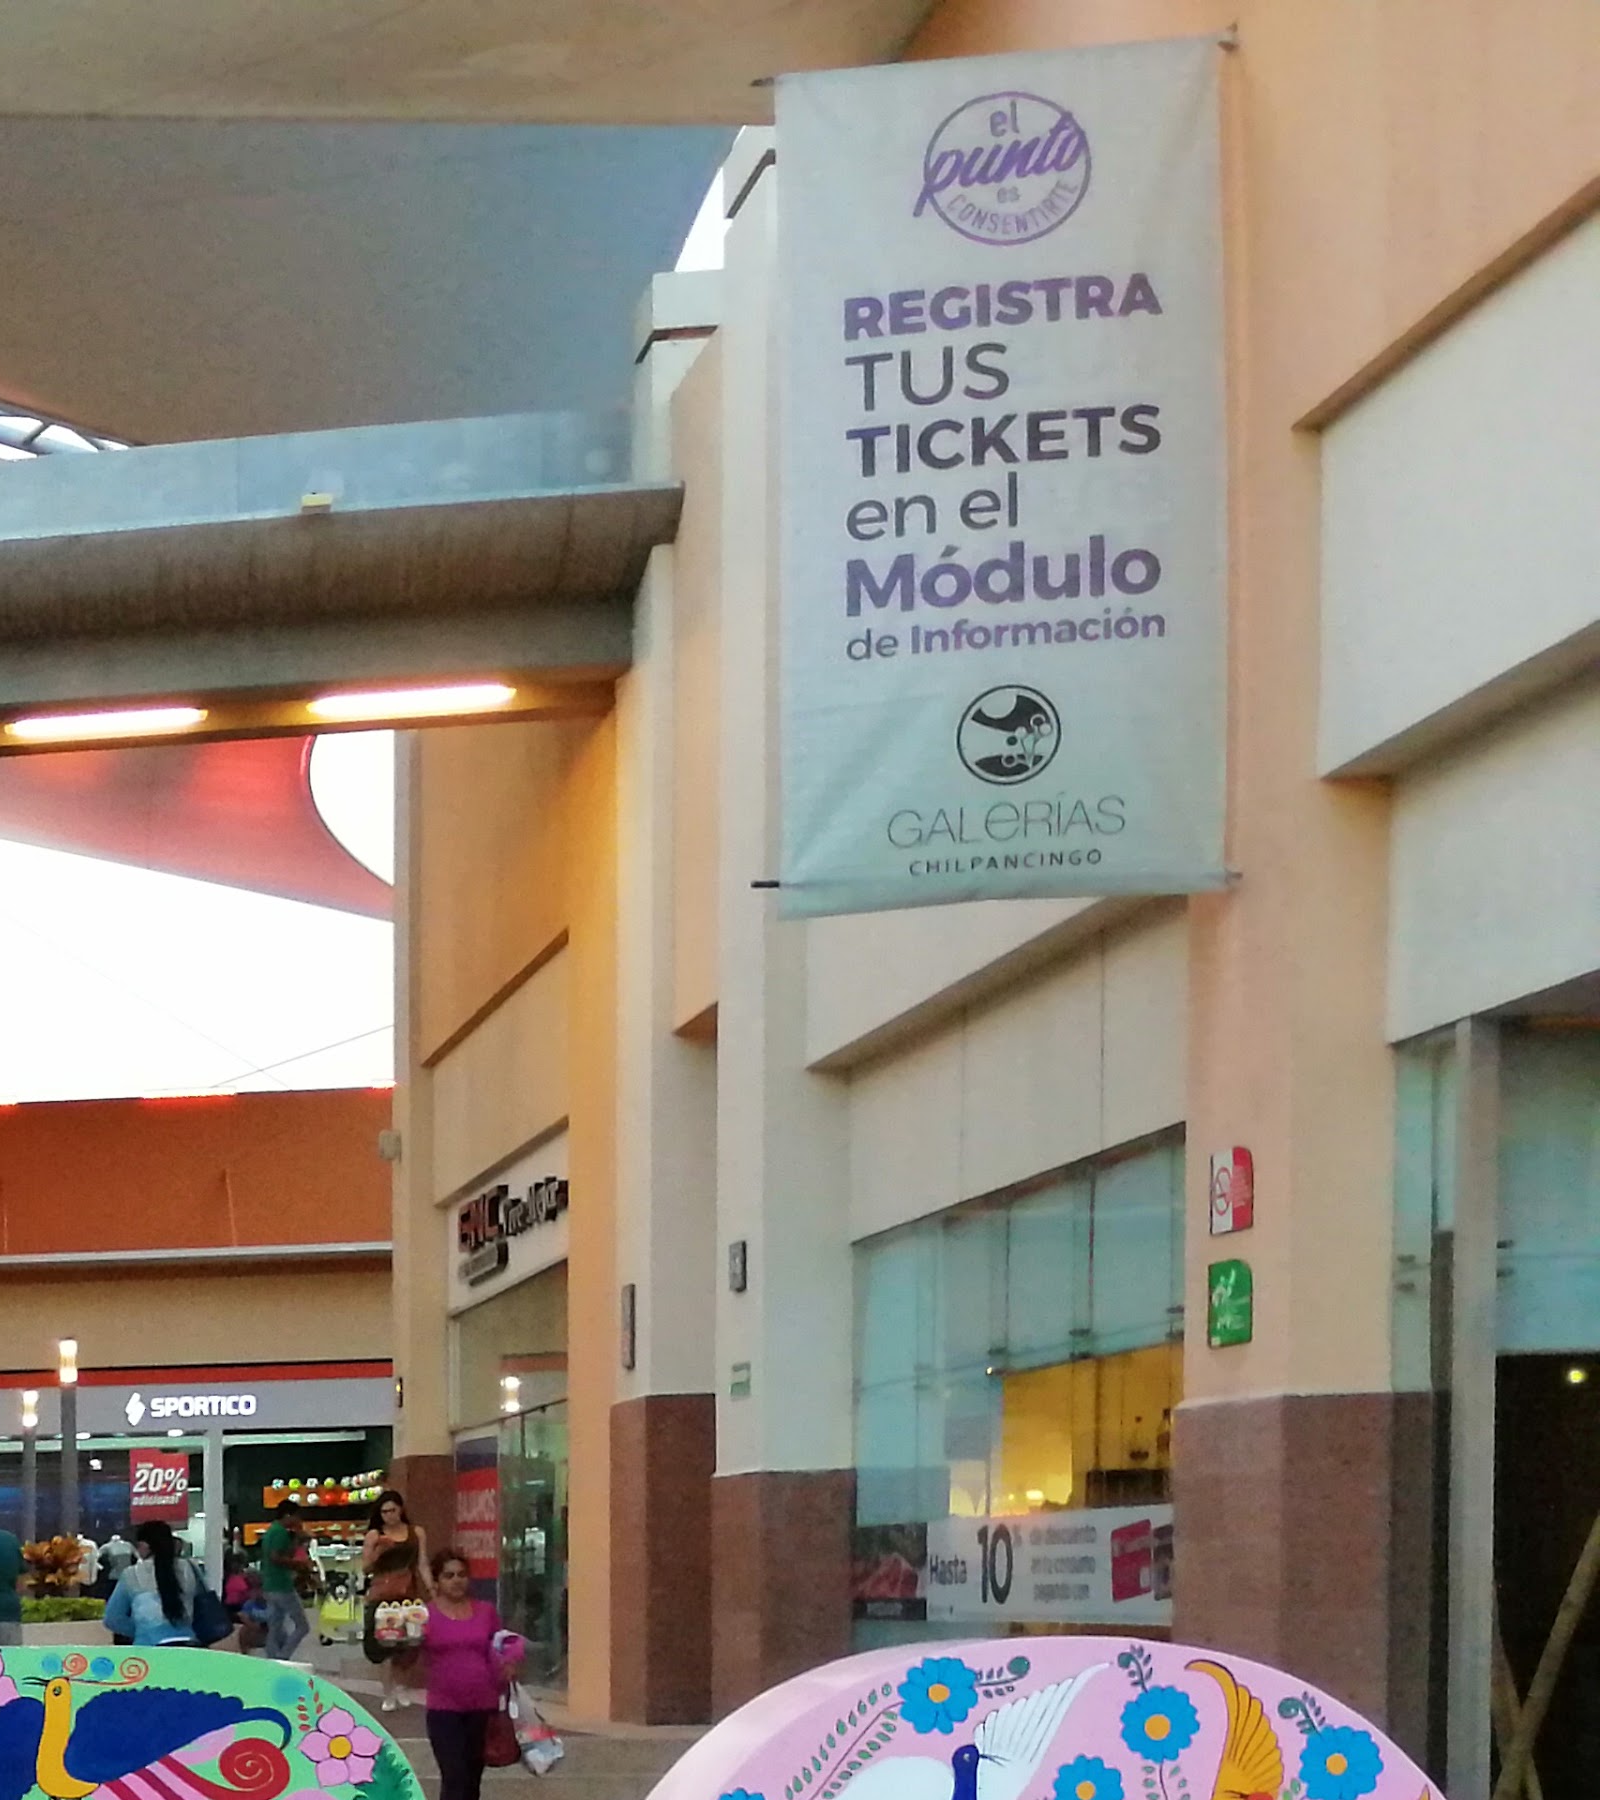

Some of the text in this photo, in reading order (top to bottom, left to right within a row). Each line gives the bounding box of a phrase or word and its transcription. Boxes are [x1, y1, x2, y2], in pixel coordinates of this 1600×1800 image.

[990, 100, 1019, 137] el
[913, 112, 1086, 217] punto
[947, 181, 1078, 234] CONSENTIRTE
[844, 273, 1163, 341] REGISTRA
[845, 343, 1009, 411] TUS
[846, 404, 1161, 477] TICKETS
[846, 471, 1018, 541] en el
[846, 534, 1161, 617] Módulo
[846, 607, 1166, 661] de Información
[909, 848, 1102, 876] CHILPANCINGO
[150, 1395, 257, 1417] SPORTICO
[132, 1468, 188, 1493] 20%
[930, 1553, 968, 1585] Hasta
